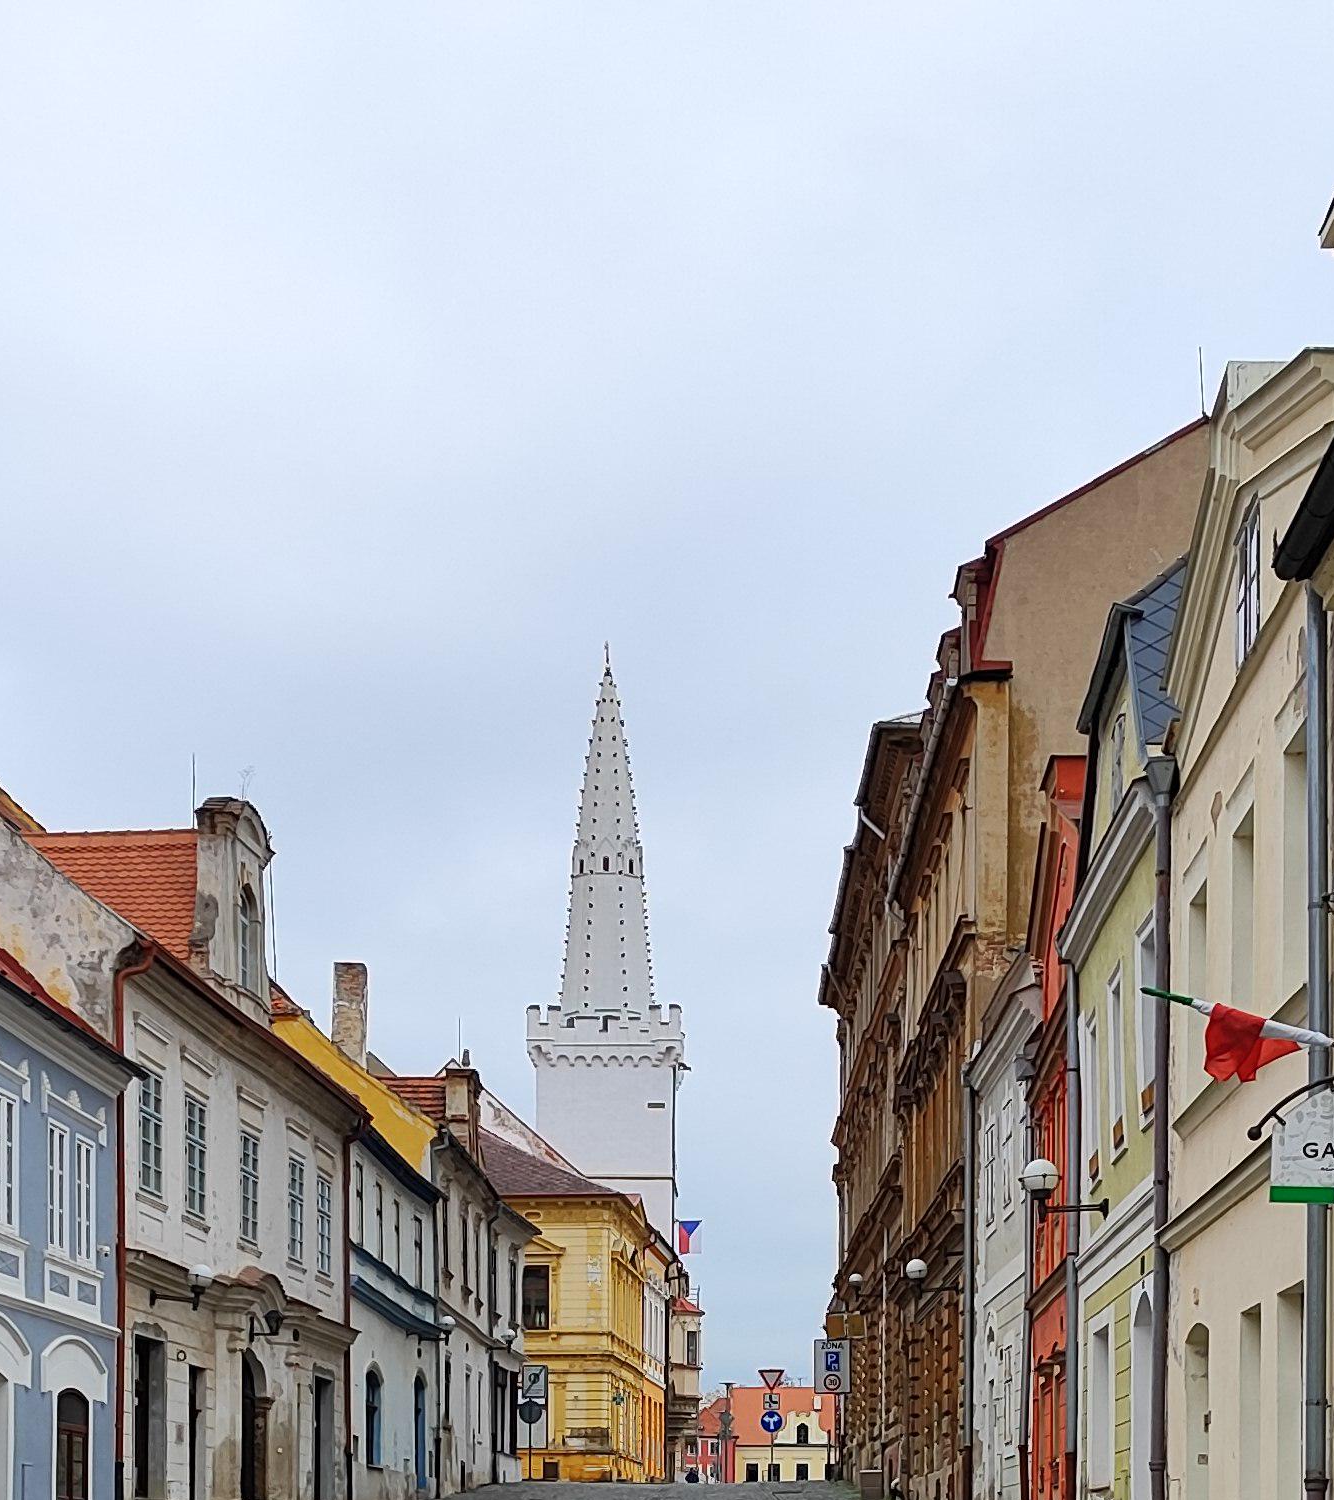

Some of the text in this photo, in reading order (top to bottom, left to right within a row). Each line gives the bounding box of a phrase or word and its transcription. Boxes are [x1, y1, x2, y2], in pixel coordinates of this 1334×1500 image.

[820, 1341, 844, 1350] ZONA
[827, 1353, 837, 1366] P
[827, 1378, 838, 1386] 30
